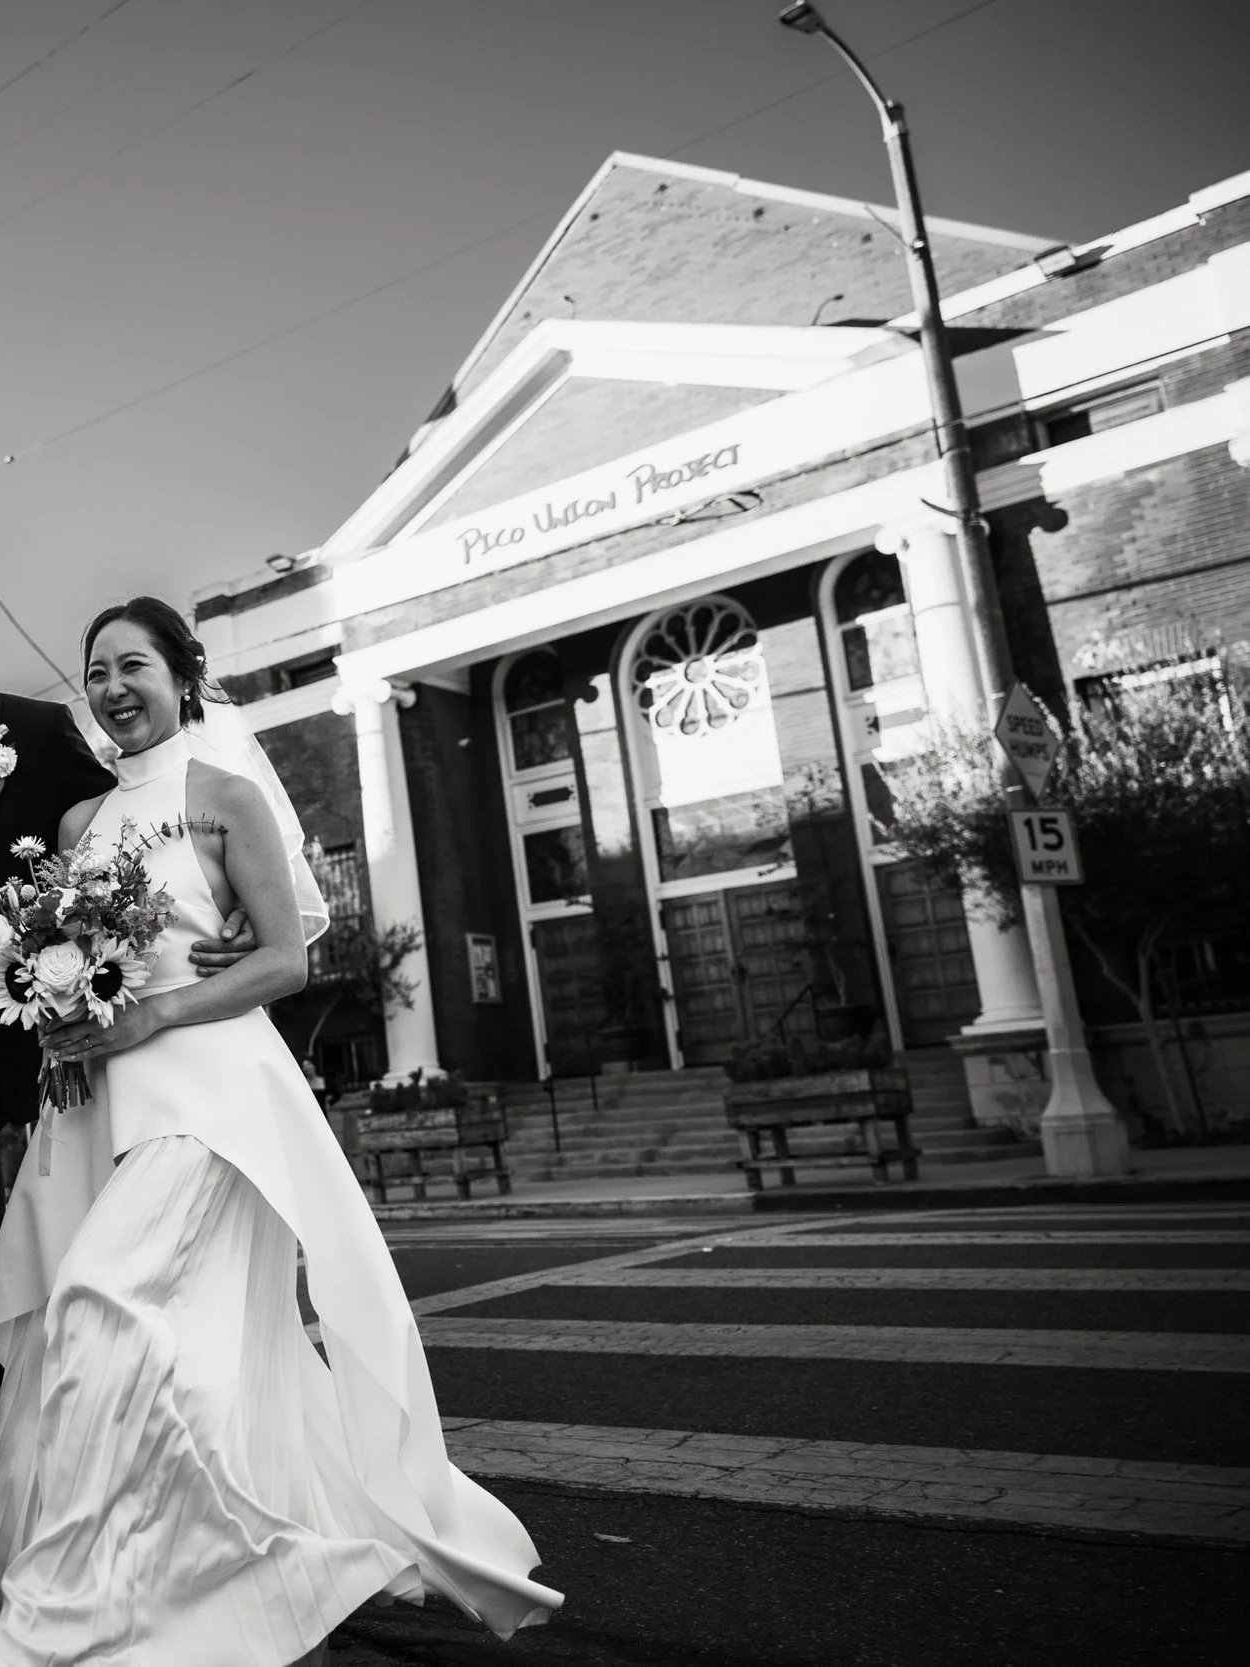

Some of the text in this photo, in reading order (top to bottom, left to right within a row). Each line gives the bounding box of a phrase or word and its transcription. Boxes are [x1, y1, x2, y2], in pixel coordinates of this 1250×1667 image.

[1006, 714, 1044, 737] SPEED
[1009, 739, 1050, 763] HUMPS
[1023, 817, 1064, 851] 15
[1031, 860, 1069, 875] MPH
